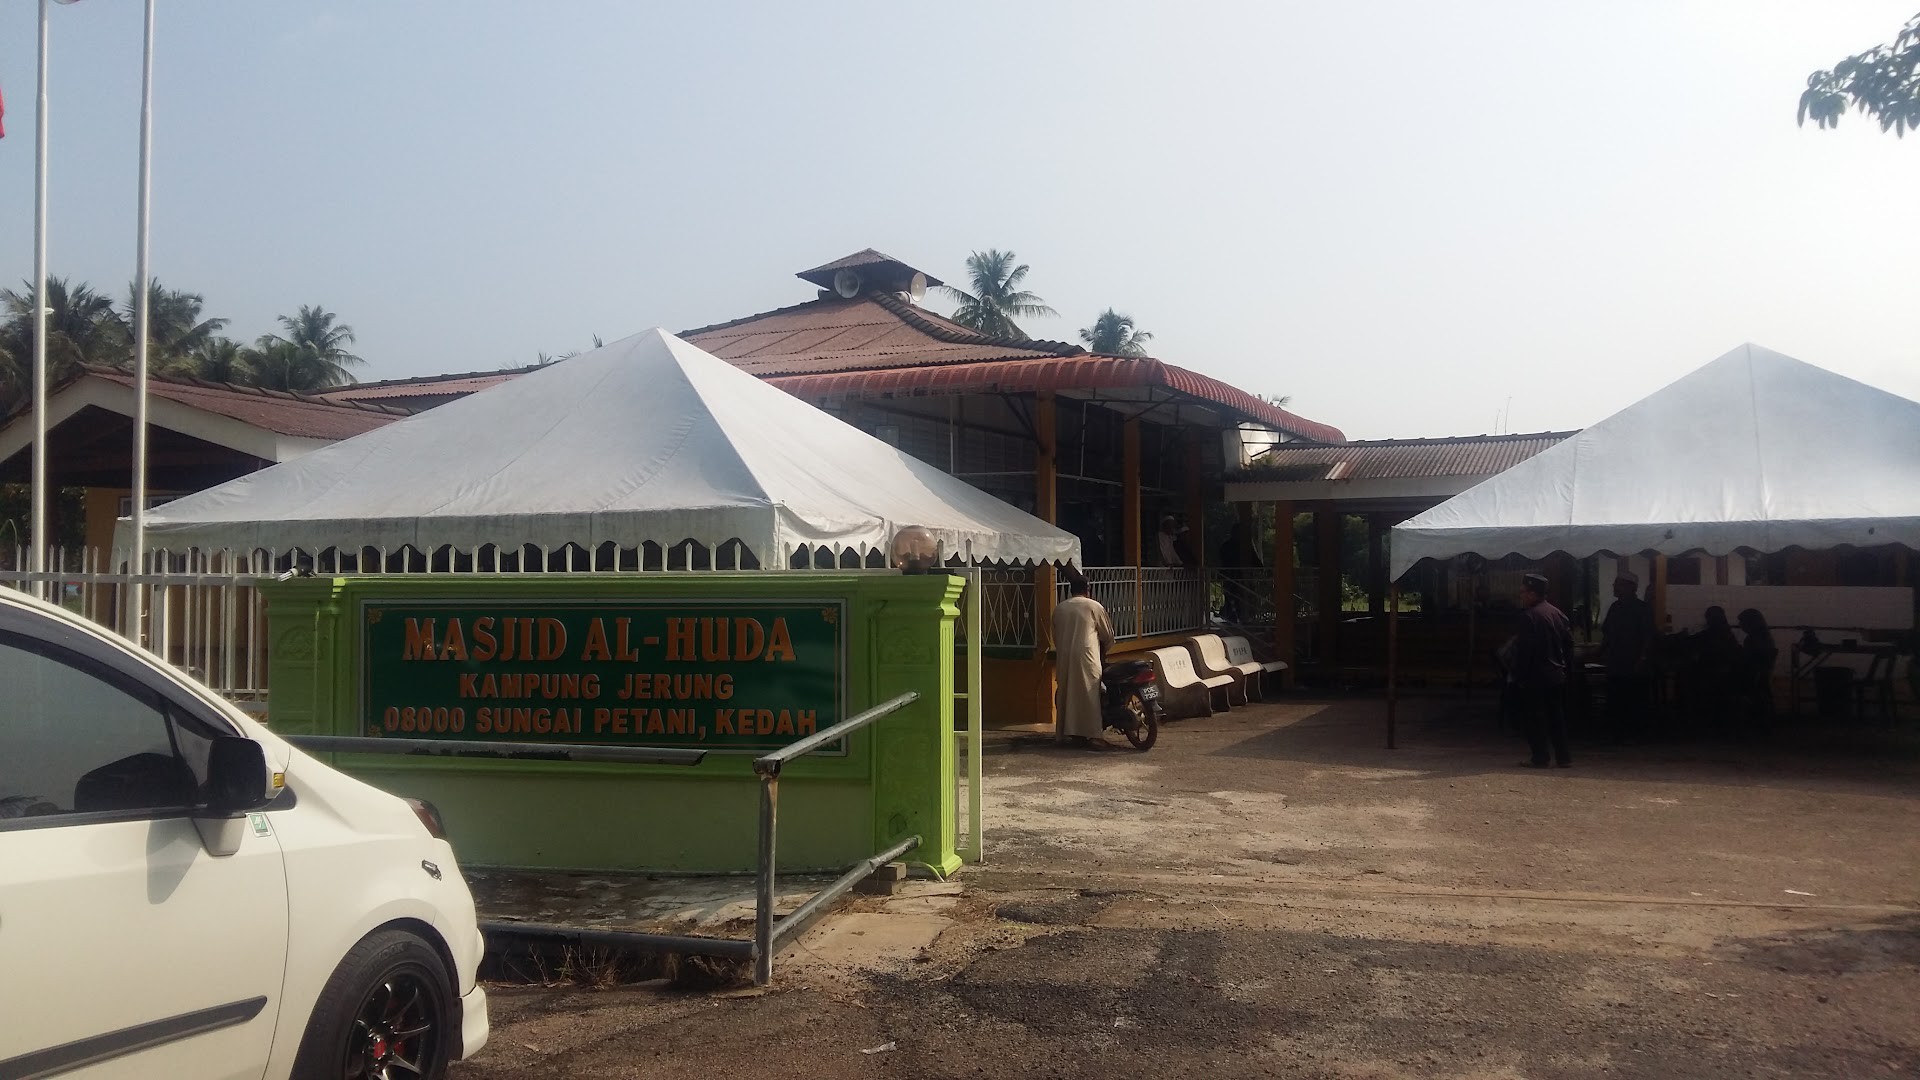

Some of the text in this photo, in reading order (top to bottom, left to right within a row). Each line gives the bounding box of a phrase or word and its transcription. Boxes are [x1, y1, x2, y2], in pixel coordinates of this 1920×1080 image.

[403, 617, 797, 662] MASJID AL-HUDA
[459, 673, 735, 700] KAMPUNG JERUNG
[384, 706, 817, 740] 08000 SUNGAI PETANI, KEDAH
